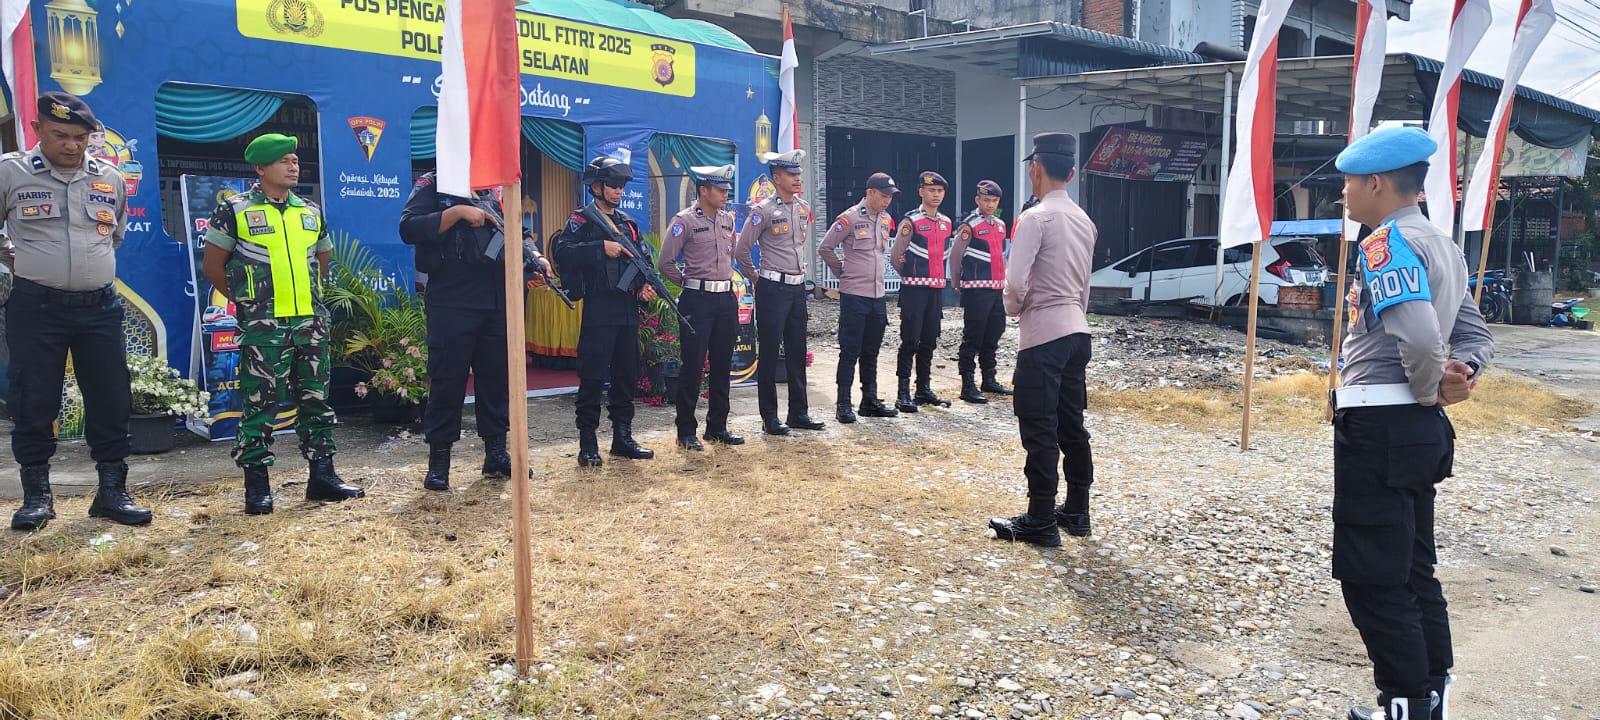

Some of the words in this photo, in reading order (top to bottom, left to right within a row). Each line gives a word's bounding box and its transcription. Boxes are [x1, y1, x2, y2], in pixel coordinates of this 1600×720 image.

[386, 0, 446, 23] PENGA
[555, 26, 595, 48] FITRI
[599, 34, 632, 55] 2025
[523, 50, 589, 75] SELATAN
[1128, 132, 1163, 146] BENGKEL
[1143, 146, 1172, 159] MOTOR
[339, 171, 369, 185] Operasi
[371, 173, 400, 186] Ketupat
[17, 191, 52, 200] HARIST
[377, 187, 400, 198] 2025
[126, 207, 146, 217] UK
[125, 222, 151, 231] KAT
[733, 344, 752, 352] LATAN
[217, 379, 241, 391] ACE
